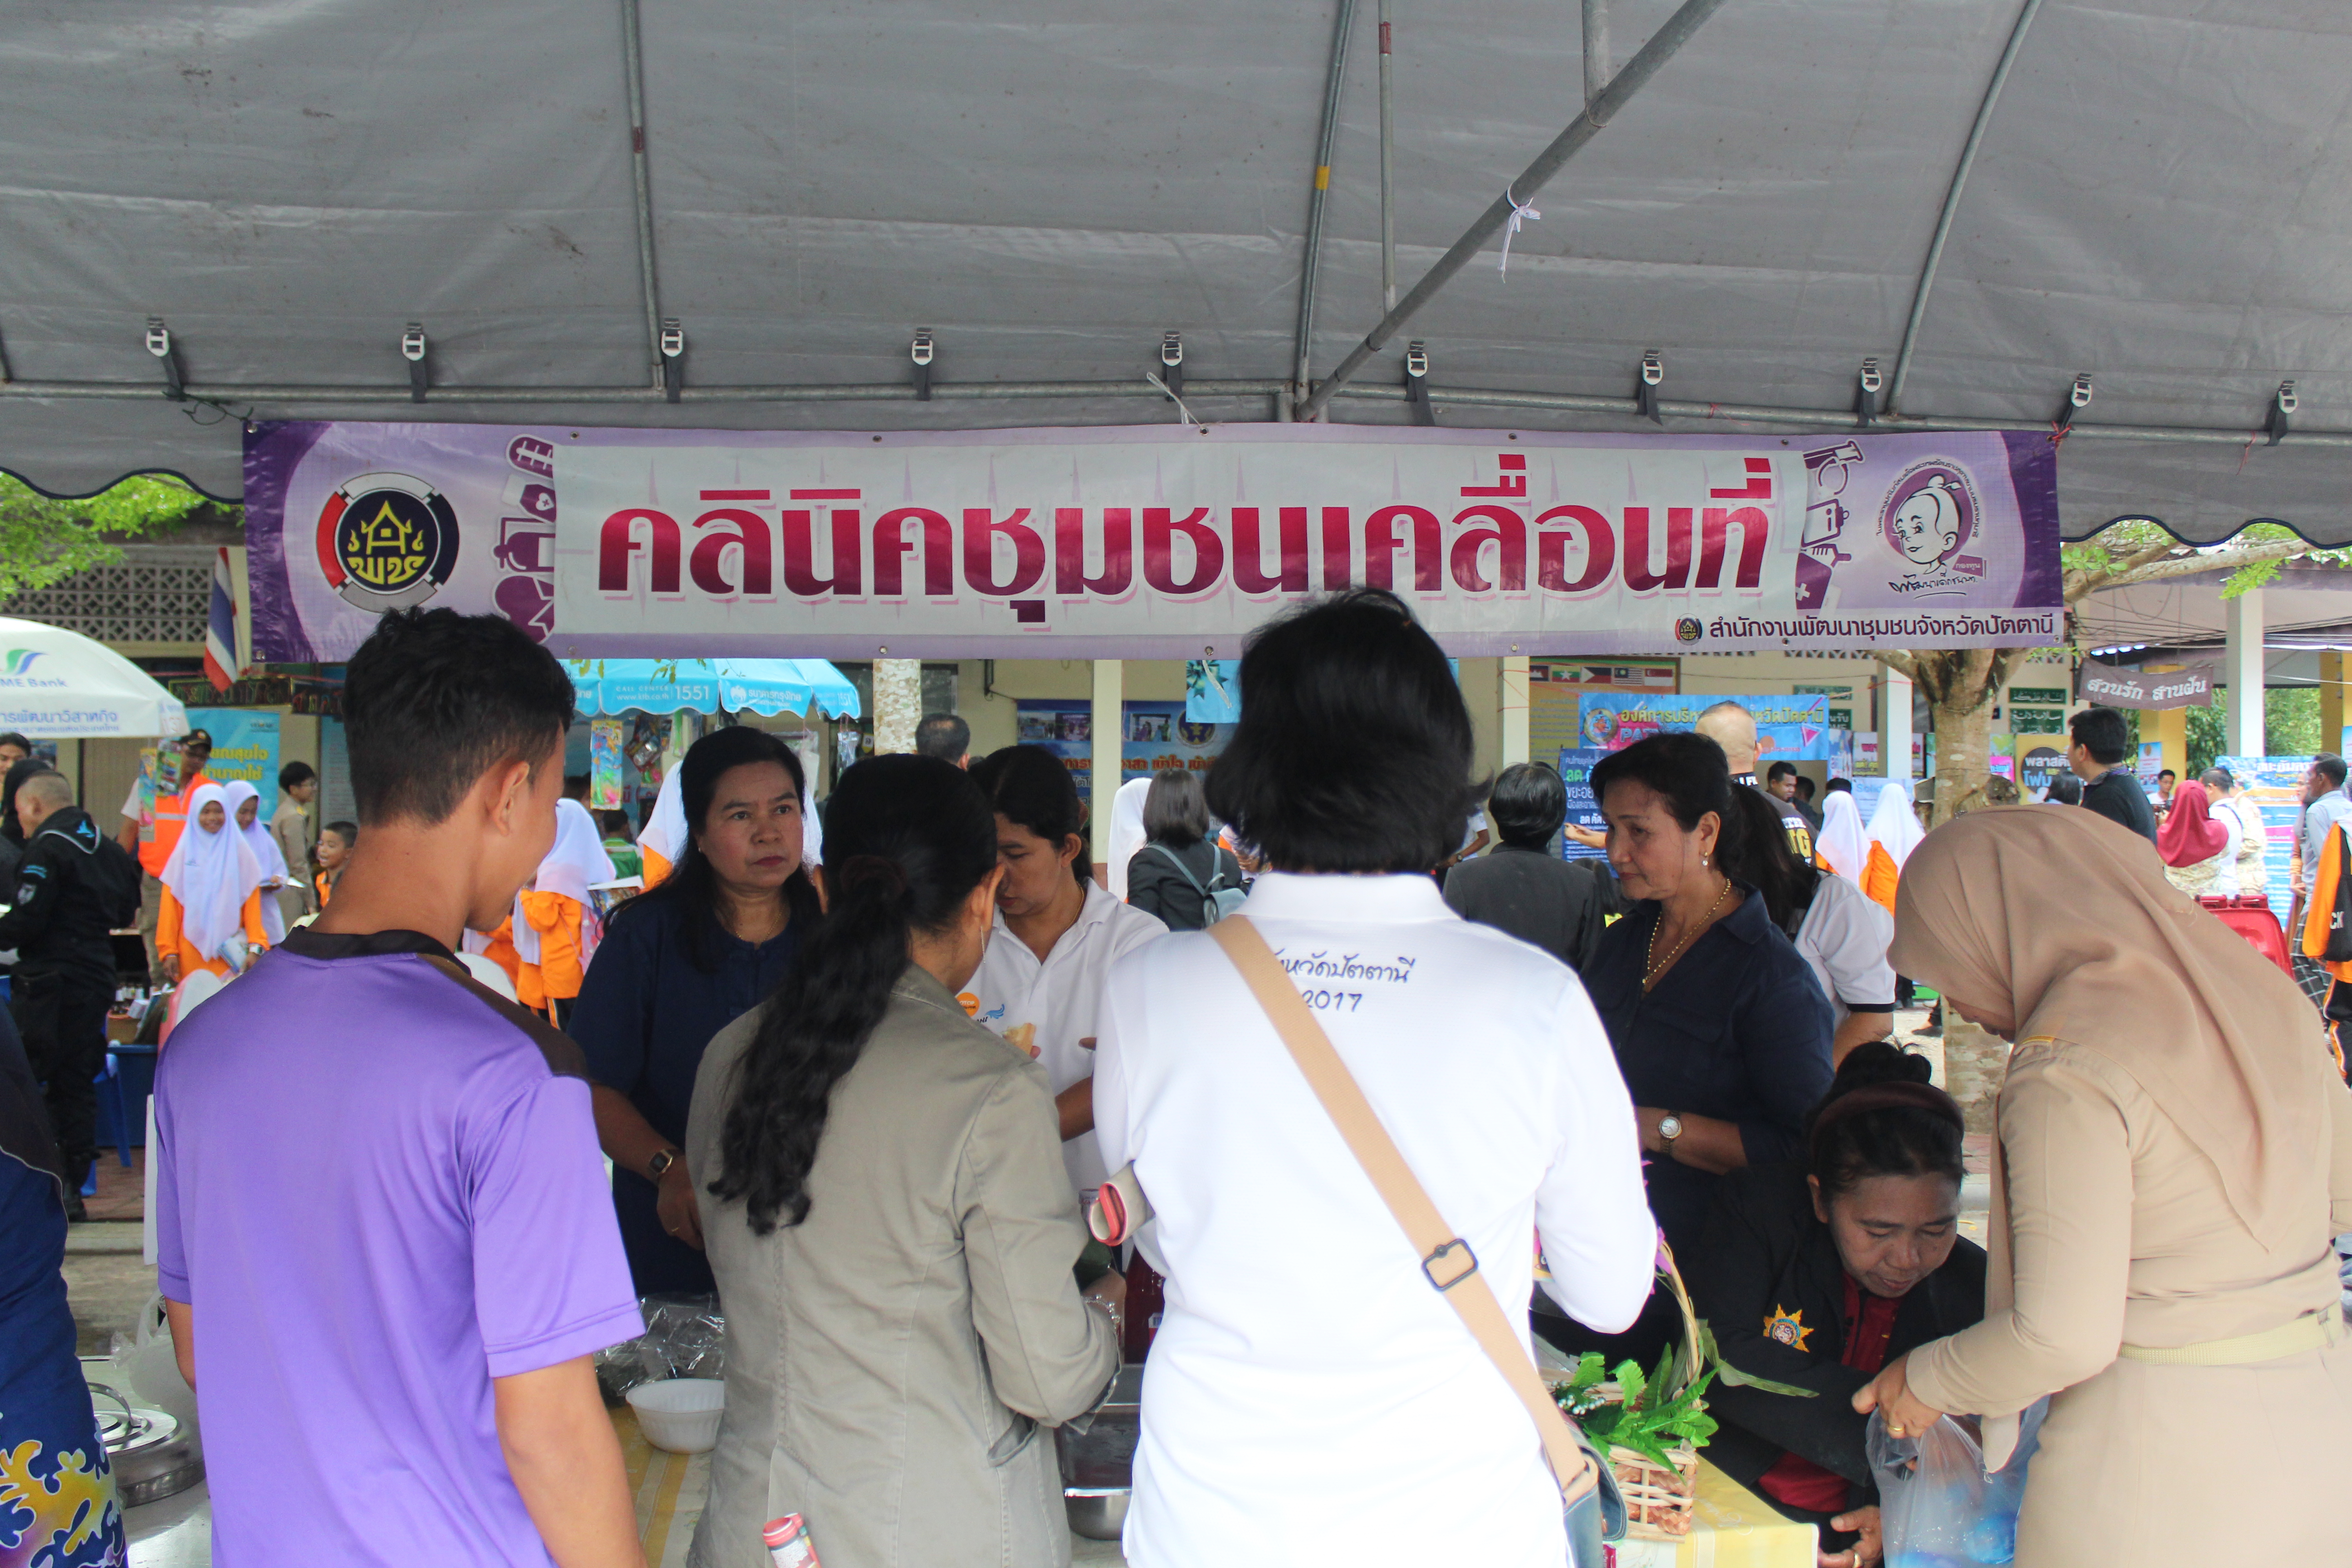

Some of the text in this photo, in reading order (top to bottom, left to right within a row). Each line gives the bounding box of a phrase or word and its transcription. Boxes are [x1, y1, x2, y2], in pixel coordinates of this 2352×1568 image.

[599, 454, 1771, 622] คลินิคชุมชนเคลื่อนที่
[1710, 613, 2053, 641] สำนักงานพัฒนาชุมชนจังหวัดปัตตานี
[27, 678, 69, 688] Bank
[2087, 678, 2145, 700] สวนรัก
[675, 686, 709, 701] 1551
[748, 689, 802, 702] ธนาคารกรุงไทย
[1566, 769, 1583, 783] ลด
[1301, 989, 1363, 1012] 2017
